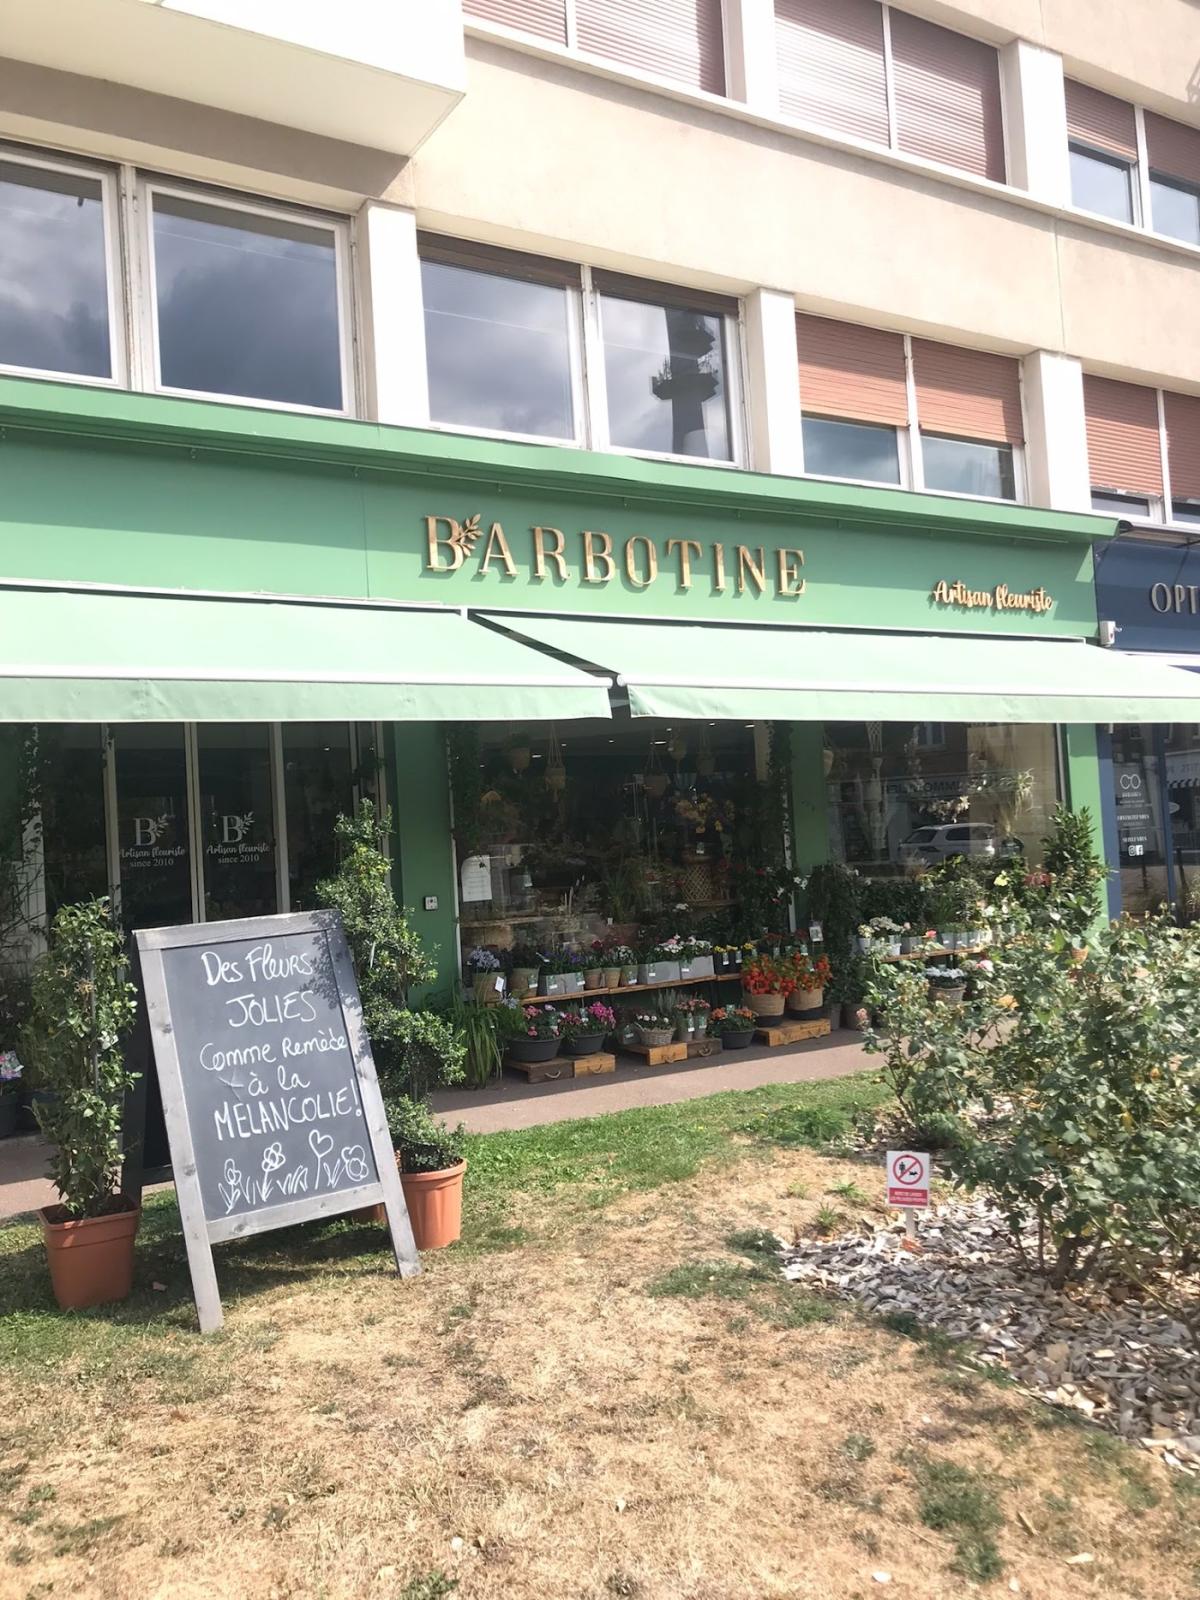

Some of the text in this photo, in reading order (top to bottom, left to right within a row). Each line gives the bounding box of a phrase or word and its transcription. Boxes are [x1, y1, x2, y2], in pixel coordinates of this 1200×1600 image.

[424, 514, 807, 597] BARBOTINE
[933, 579, 1054, 613] Artisan fleuriste
[1151, 582, 1199, 614] OPT
[130, 858, 175, 868] since 2010
[151, 846, 186, 857] fleuriste
[206, 842, 271, 855] Artisan fleuriste
[218, 854, 260, 864] since 2010
[201, 951, 243, 986] Des
[225, 990, 317, 1027] JOLIES
[200, 1028, 348, 1071] Comme Remède
[248, 1065, 311, 1096] à la
